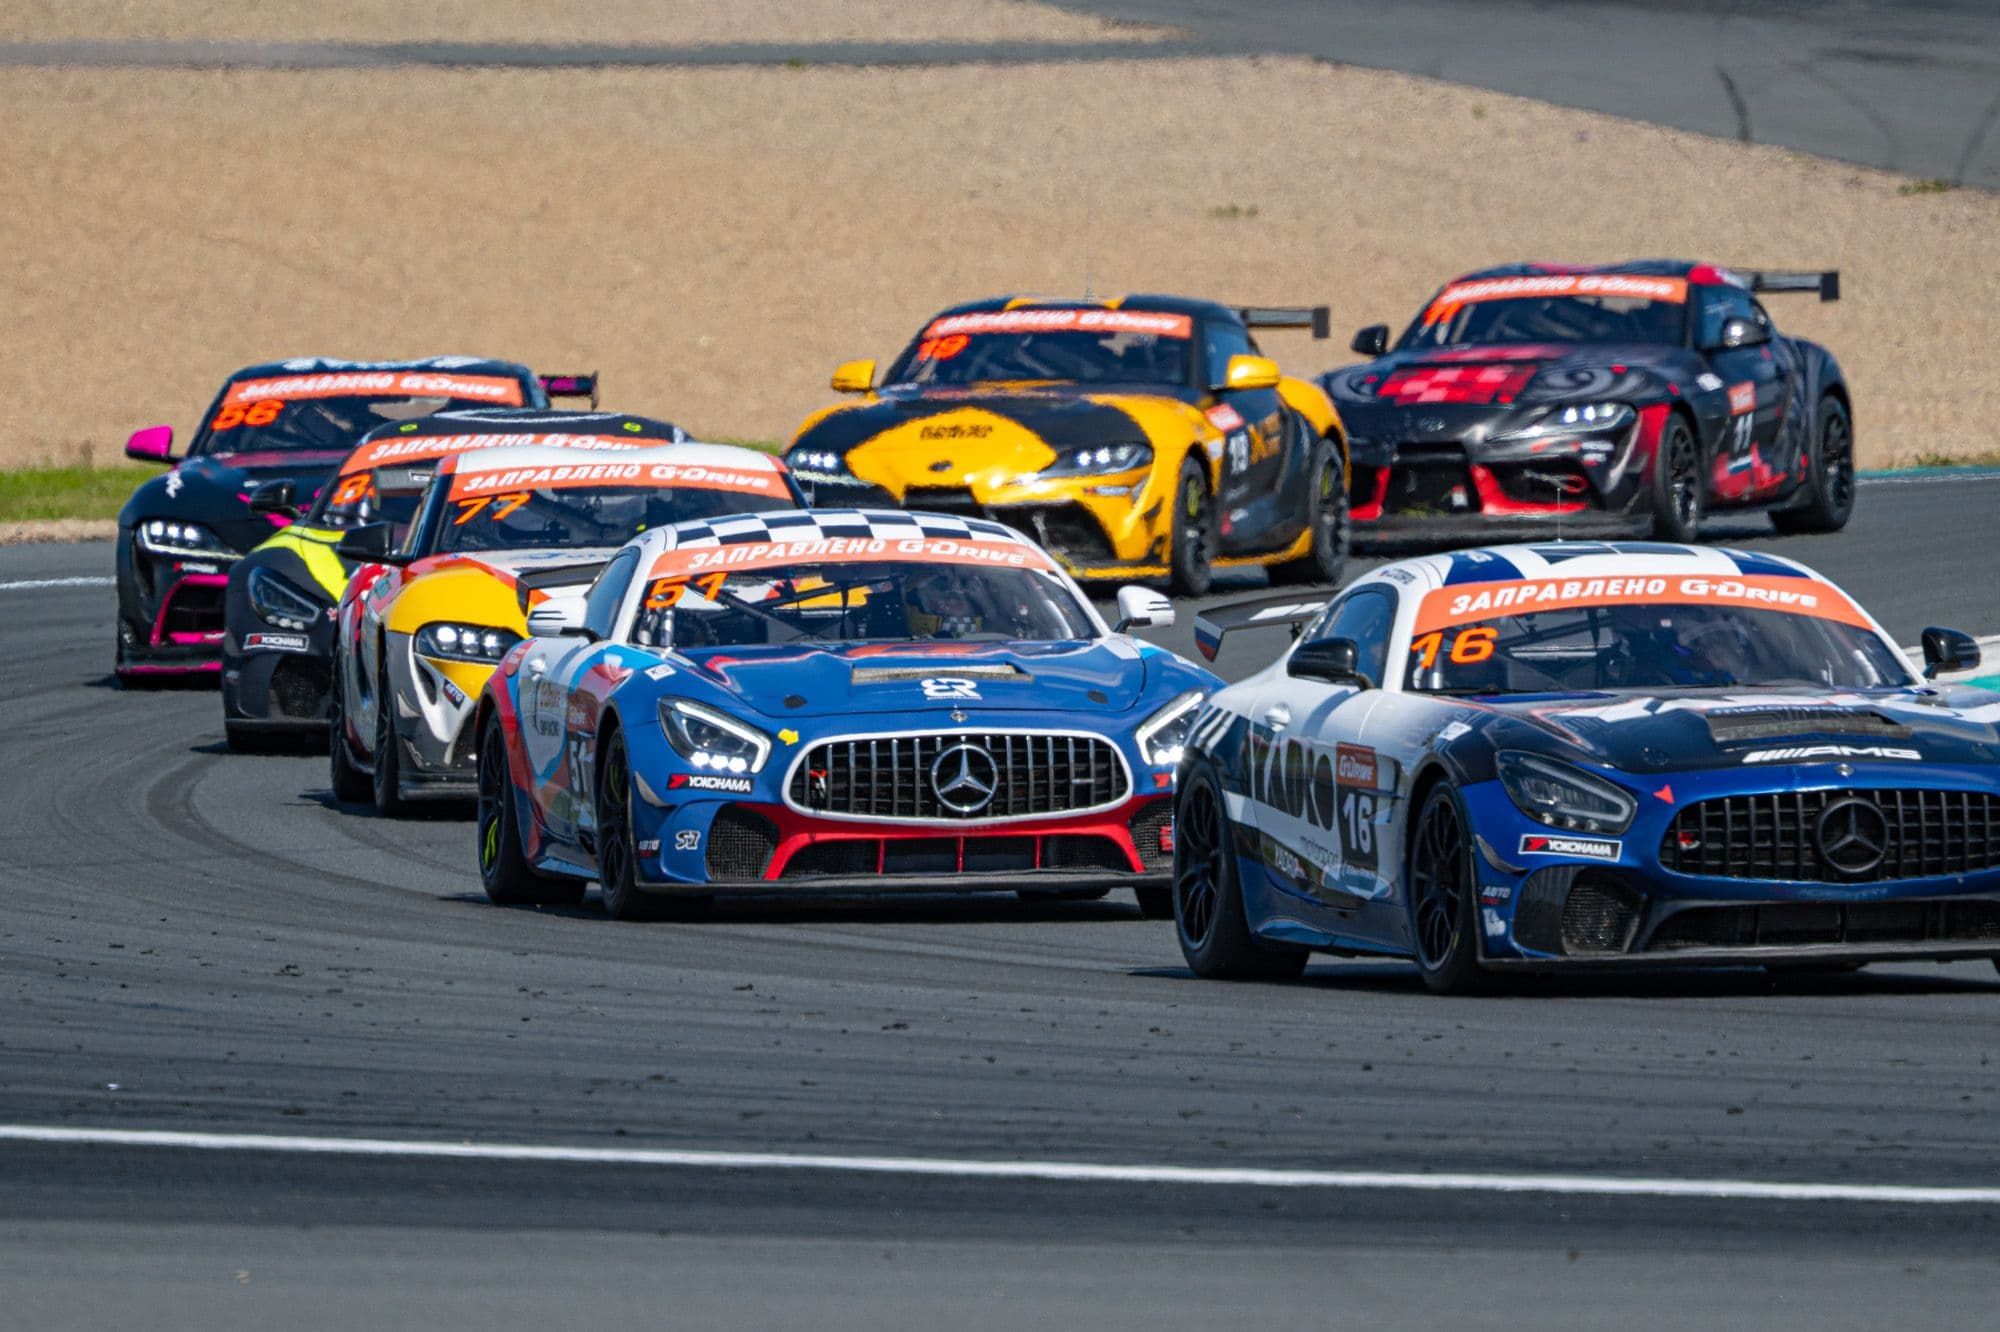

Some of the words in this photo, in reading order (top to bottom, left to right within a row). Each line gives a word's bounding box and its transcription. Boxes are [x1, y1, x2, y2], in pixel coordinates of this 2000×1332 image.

[463, 464, 641, 492] ЗАПРАВЛЕНО
[454, 492, 531, 526] 77
[687, 538, 886, 568] ЗАПРАВЛЕНО
[645, 572, 728, 608] 51
[1450, 579, 1666, 615] ЗАПРАВЛЕНО
[1411, 627, 1499, 669] 16
[688, 776, 752, 792] YOKOHAMA
[1343, 792, 1372, 854] 16
[1548, 839, 1612, 856] YOKOHAMA
